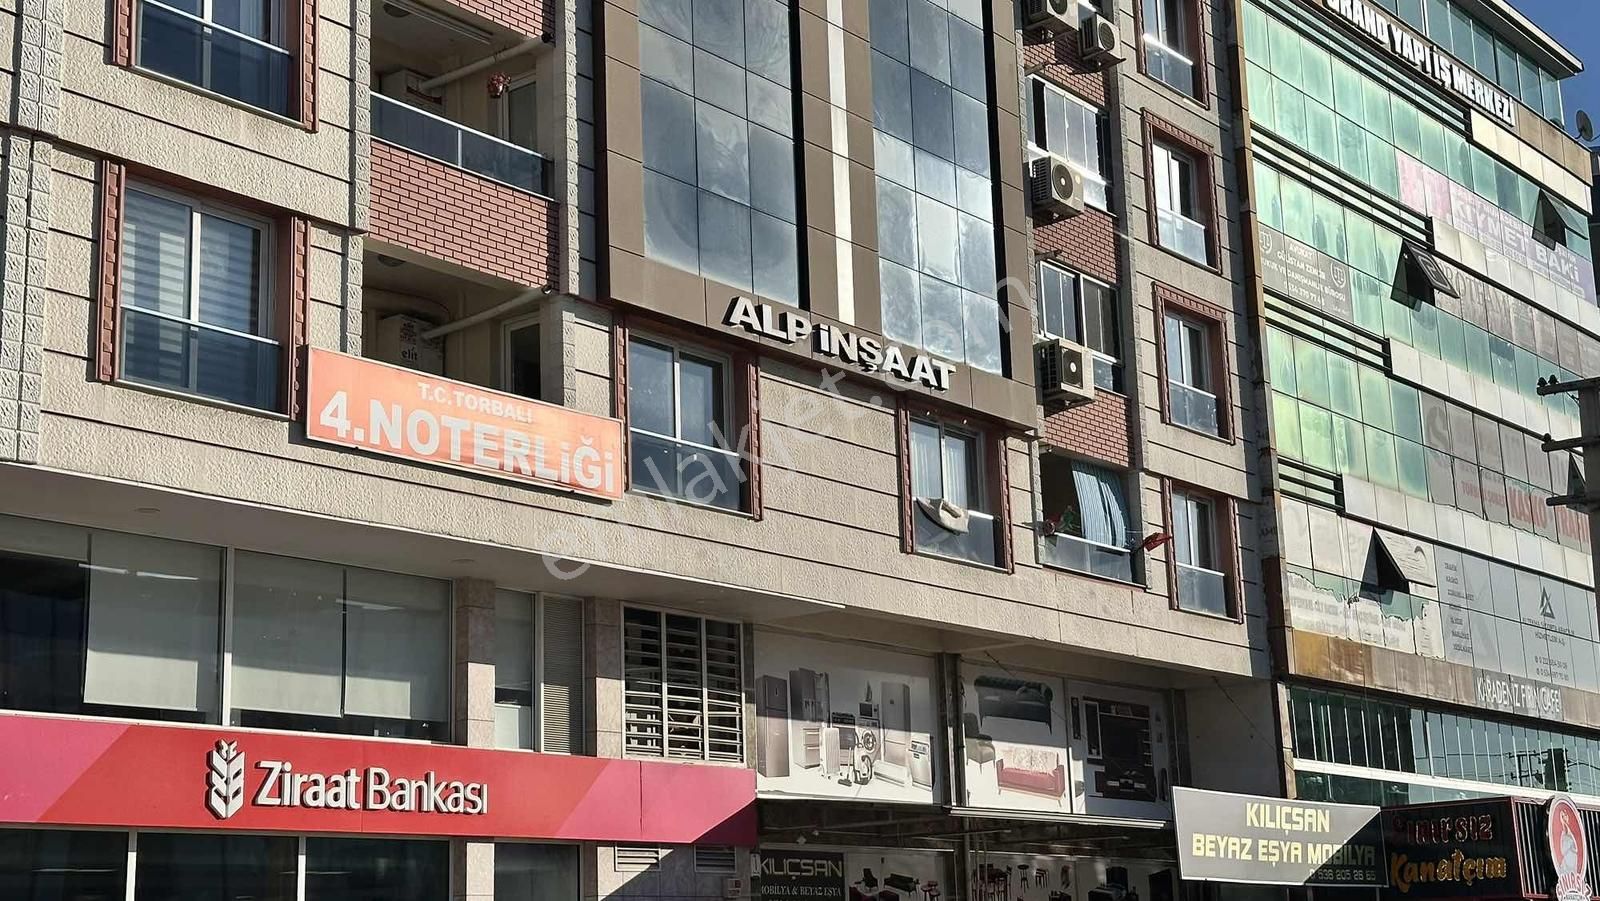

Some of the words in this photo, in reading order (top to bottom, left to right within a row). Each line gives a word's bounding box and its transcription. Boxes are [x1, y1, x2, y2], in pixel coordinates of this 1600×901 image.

[1388, 21, 1431, 75] YAPI
[1451, 63, 1516, 127] MERKEZİ
[728, 295, 813, 344] ALP
[256, 760, 361, 809] Ziraat
[366, 766, 488, 815] Bankası
[1246, 802, 1330, 836] KILIÇSAN
[760, 857, 843, 880] KILIÇSAN
[1192, 833, 1252, 860] BEYAZ
[1258, 839, 1302, 867] EŞYA
